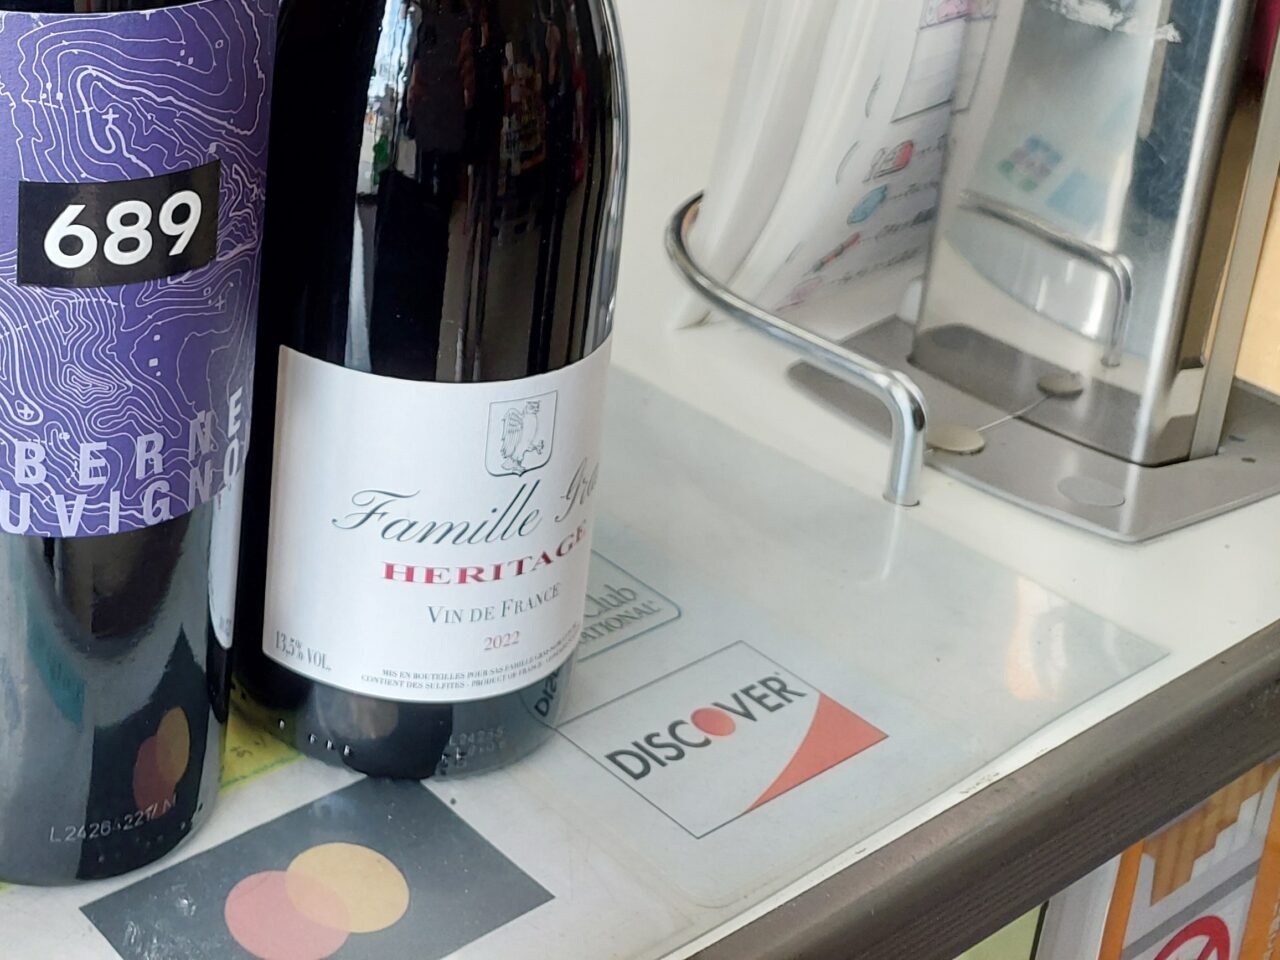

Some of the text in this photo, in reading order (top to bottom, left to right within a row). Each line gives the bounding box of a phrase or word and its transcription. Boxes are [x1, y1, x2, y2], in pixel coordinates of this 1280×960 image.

[43, 190, 203, 270] 689
[331, 479, 541, 545] Famille
[483, 630, 521, 652] 2022
[604, 675, 808, 781] DISCOVER
